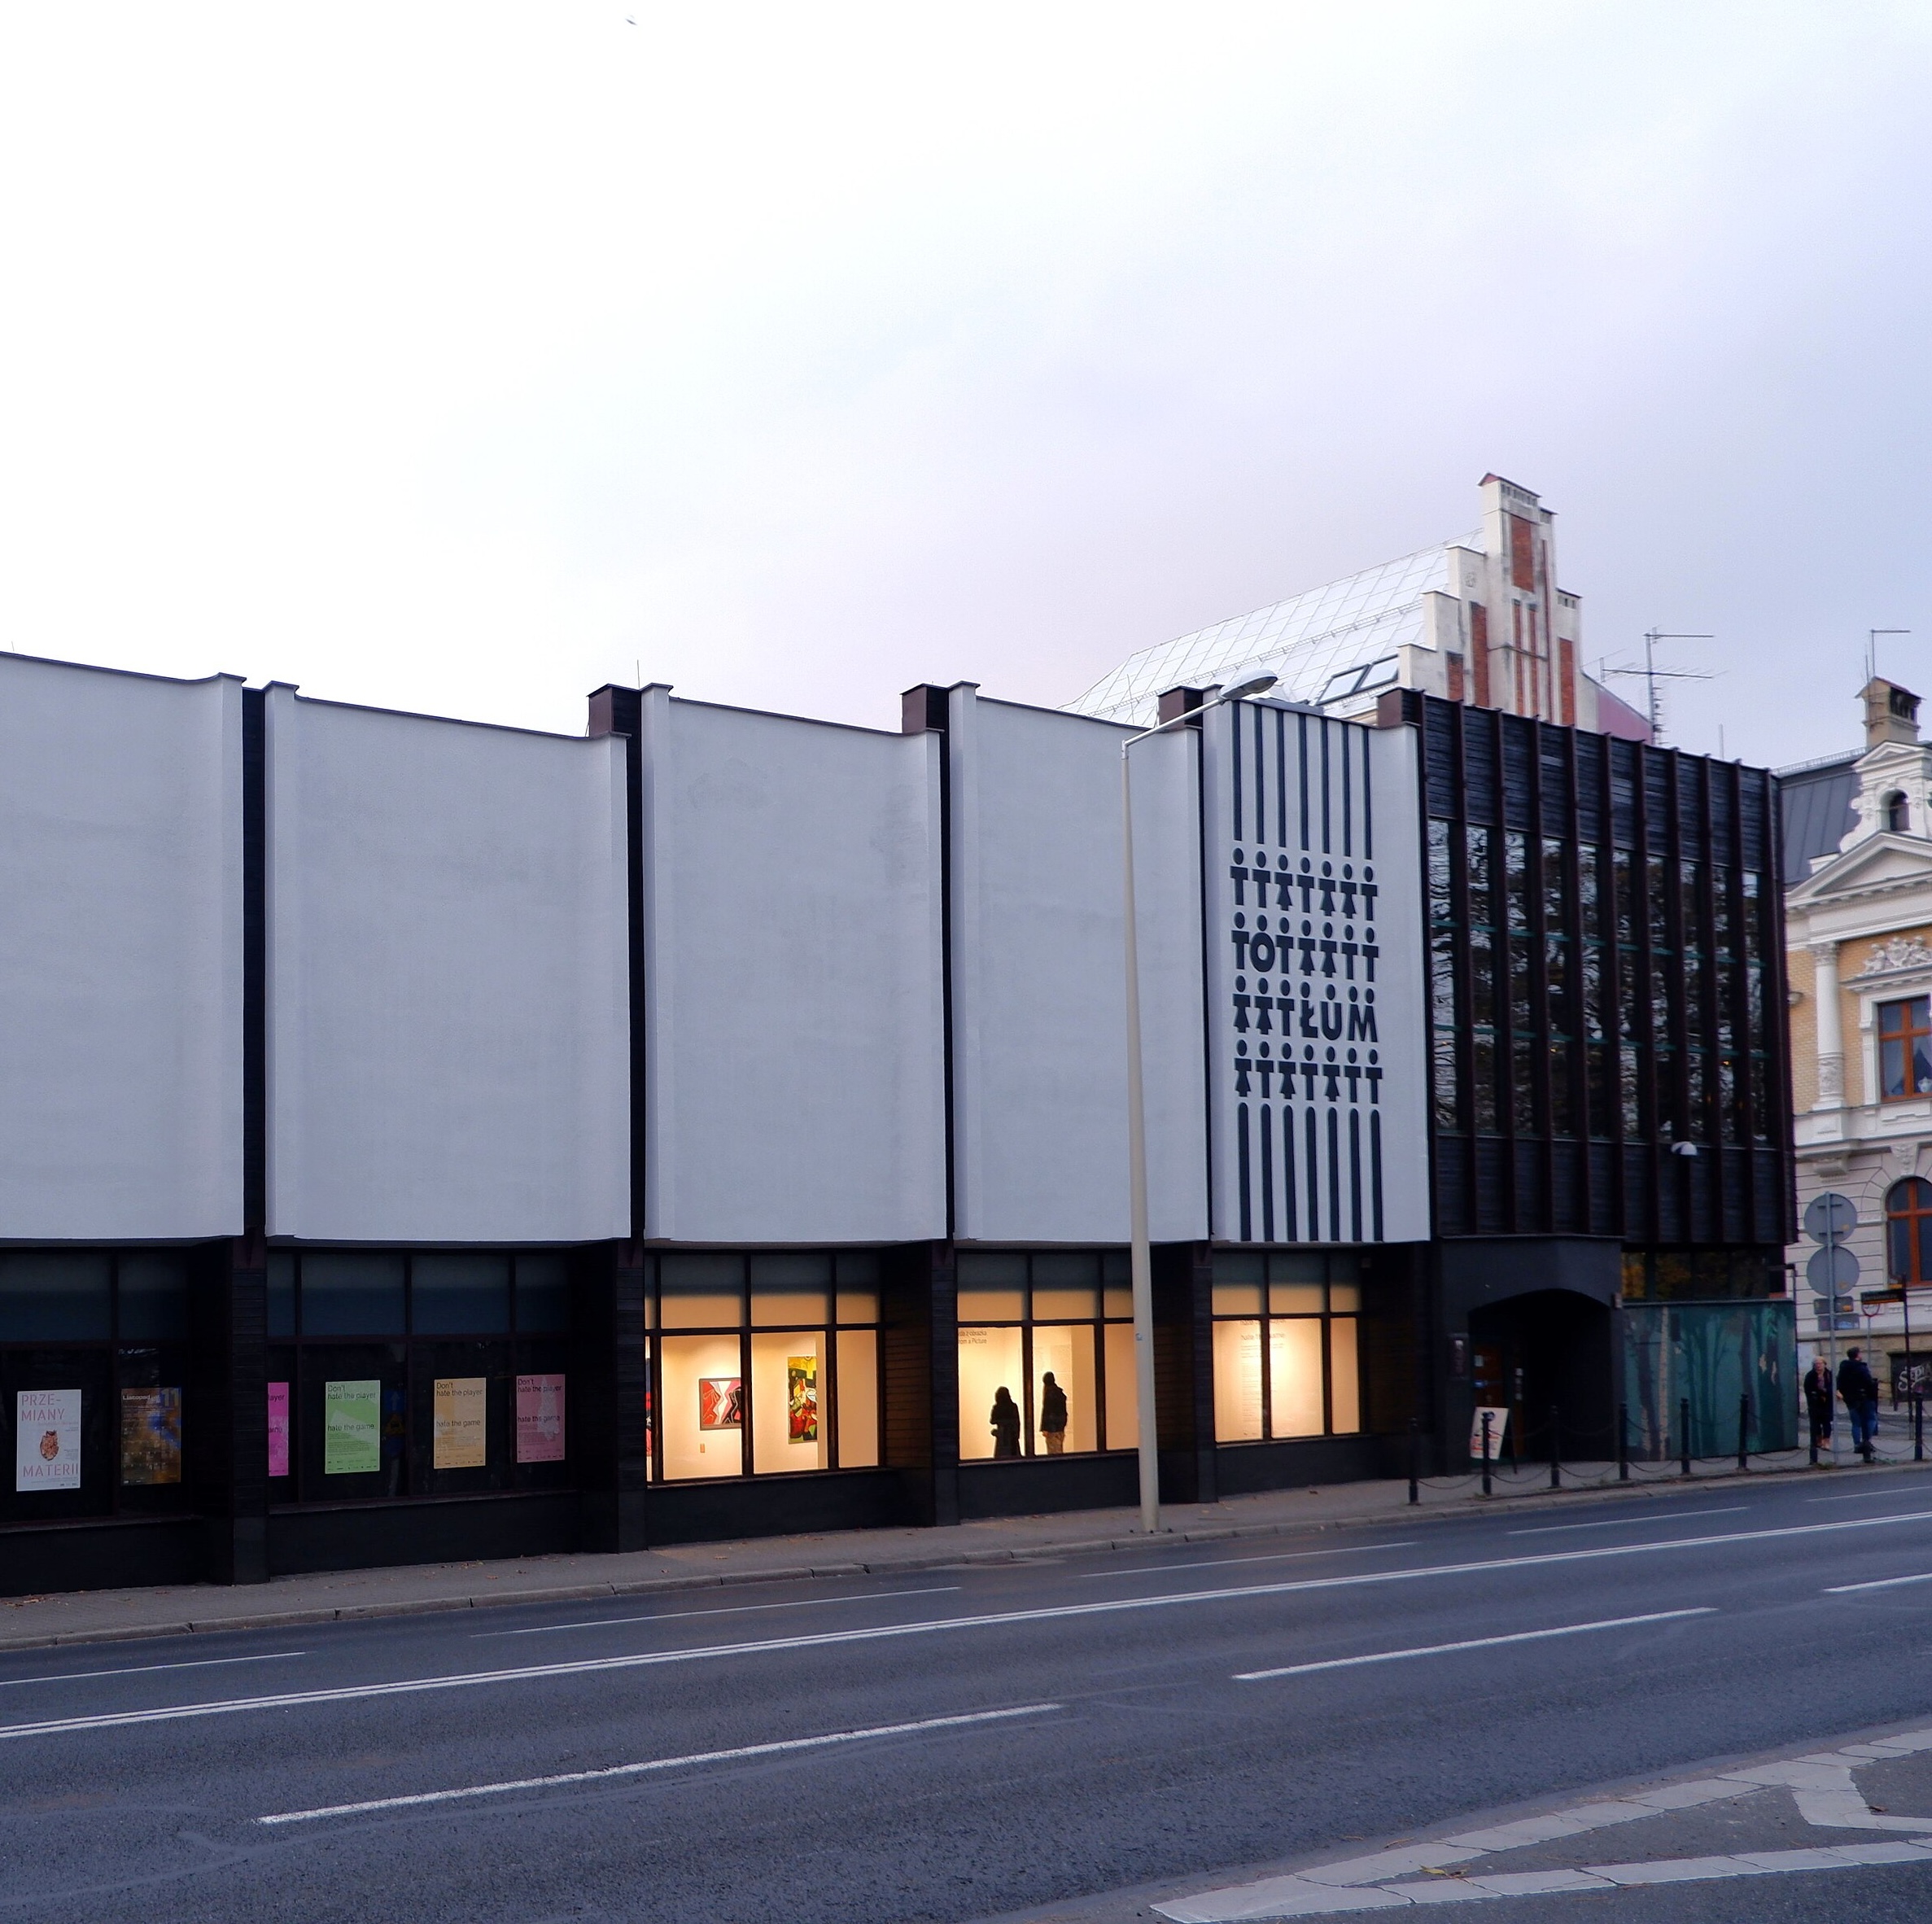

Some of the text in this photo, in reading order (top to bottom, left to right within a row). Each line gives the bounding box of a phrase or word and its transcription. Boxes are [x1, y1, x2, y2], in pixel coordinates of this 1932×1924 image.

[328, 1384, 345, 1393] Don't
[436, 1381, 453, 1389] Don't
[518, 1385, 531, 1393] hate
[543, 1384, 562, 1393] player
[356, 1391, 376, 1401] player
[436, 1389, 451, 1397] hate
[463, 1388, 483, 1397] player
[22, 1393, 61, 1406] PRZE-
[21, 1408, 65, 1421] MIANY
[543, 1415, 561, 1423] game
[356, 1423, 375, 1432] game
[452, 1419, 462, 1427] the
[463, 1419, 481, 1428] game
[23, 1463, 78, 1477] MATERII
